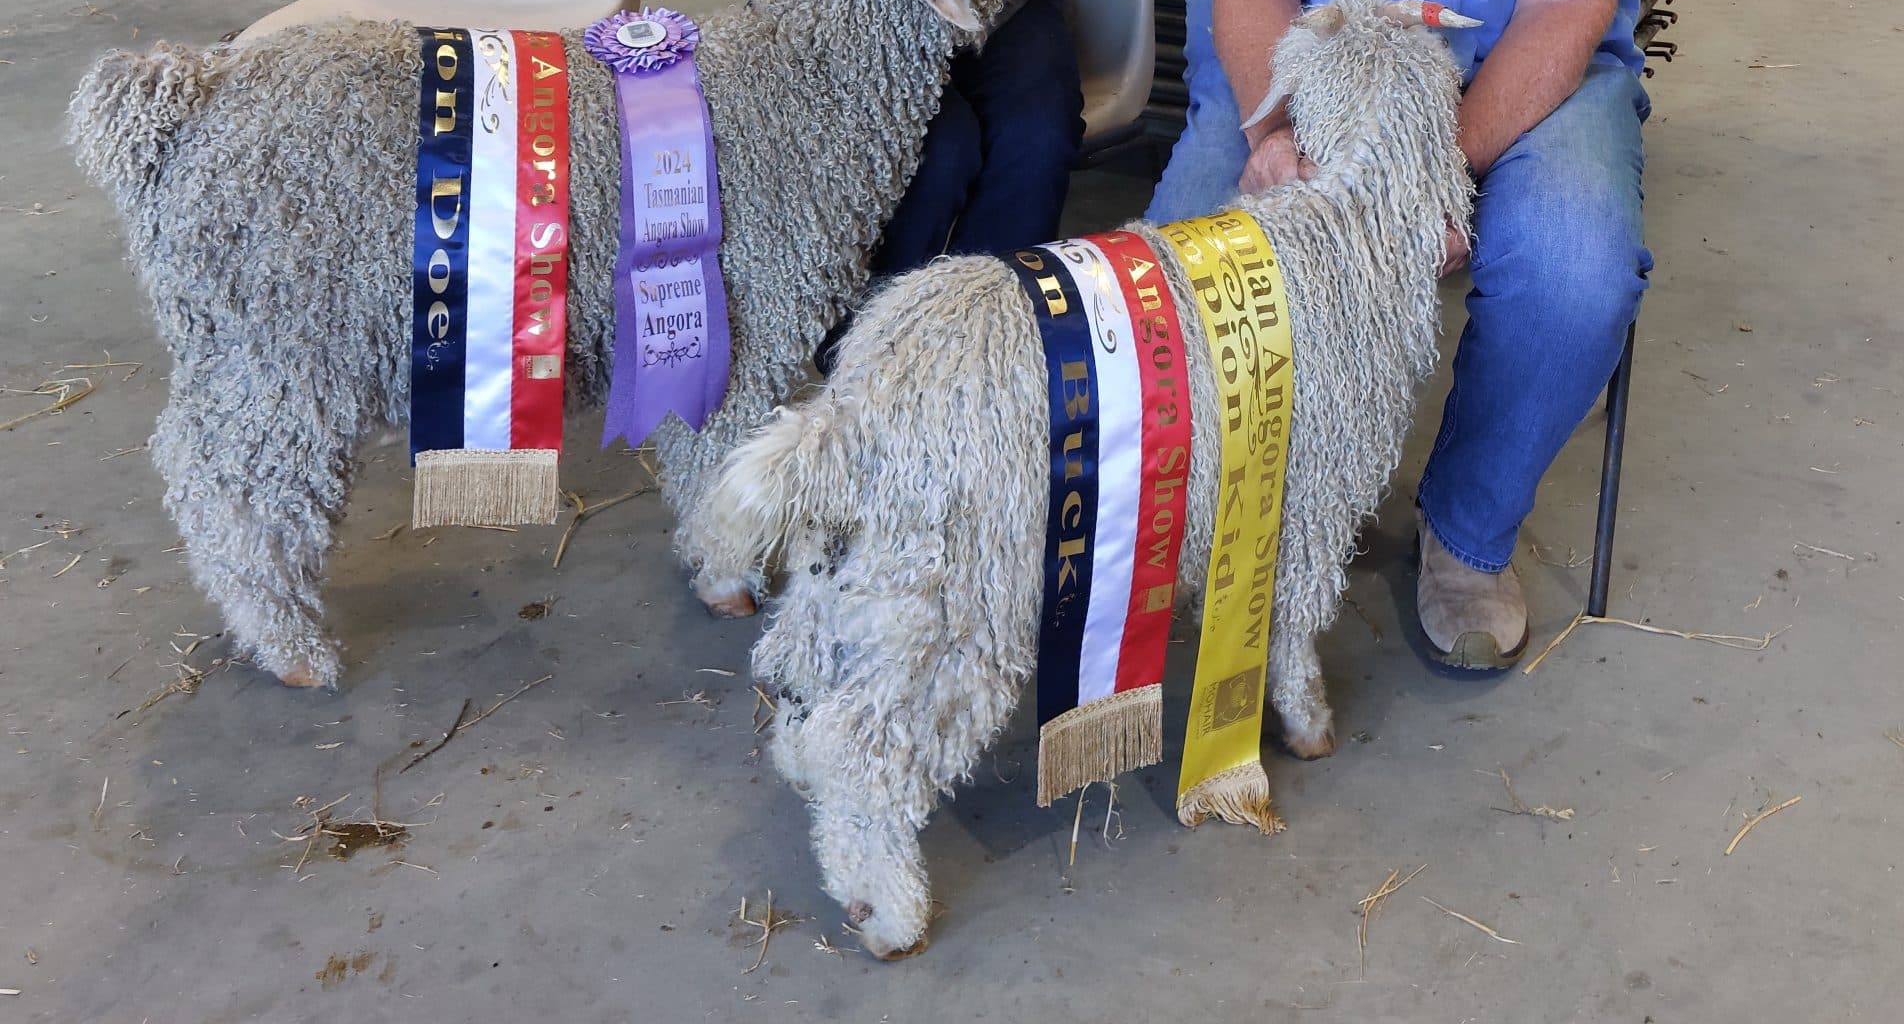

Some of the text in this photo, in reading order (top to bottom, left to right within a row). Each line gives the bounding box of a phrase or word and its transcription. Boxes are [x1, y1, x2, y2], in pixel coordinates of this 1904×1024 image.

[525, 55, 564, 208] Angora
[654, 148, 691, 175] 2024
[643, 212, 705, 248] Angora Show
[644, 179, 705, 209] Tasmanian
[428, 168, 462, 340] Doe
[528, 221, 563, 337] Show
[639, 278, 702, 308] Supreme
[642, 310, 703, 339] Angora
[1121, 253, 1187, 569] Angora Show
[1157, 223, 1246, 593] mpion Kid
[1206, 212, 1291, 650] anian Angora Show
[1056, 349, 1090, 592] Buck
[1200, 680, 1219, 736] MOHAIR
